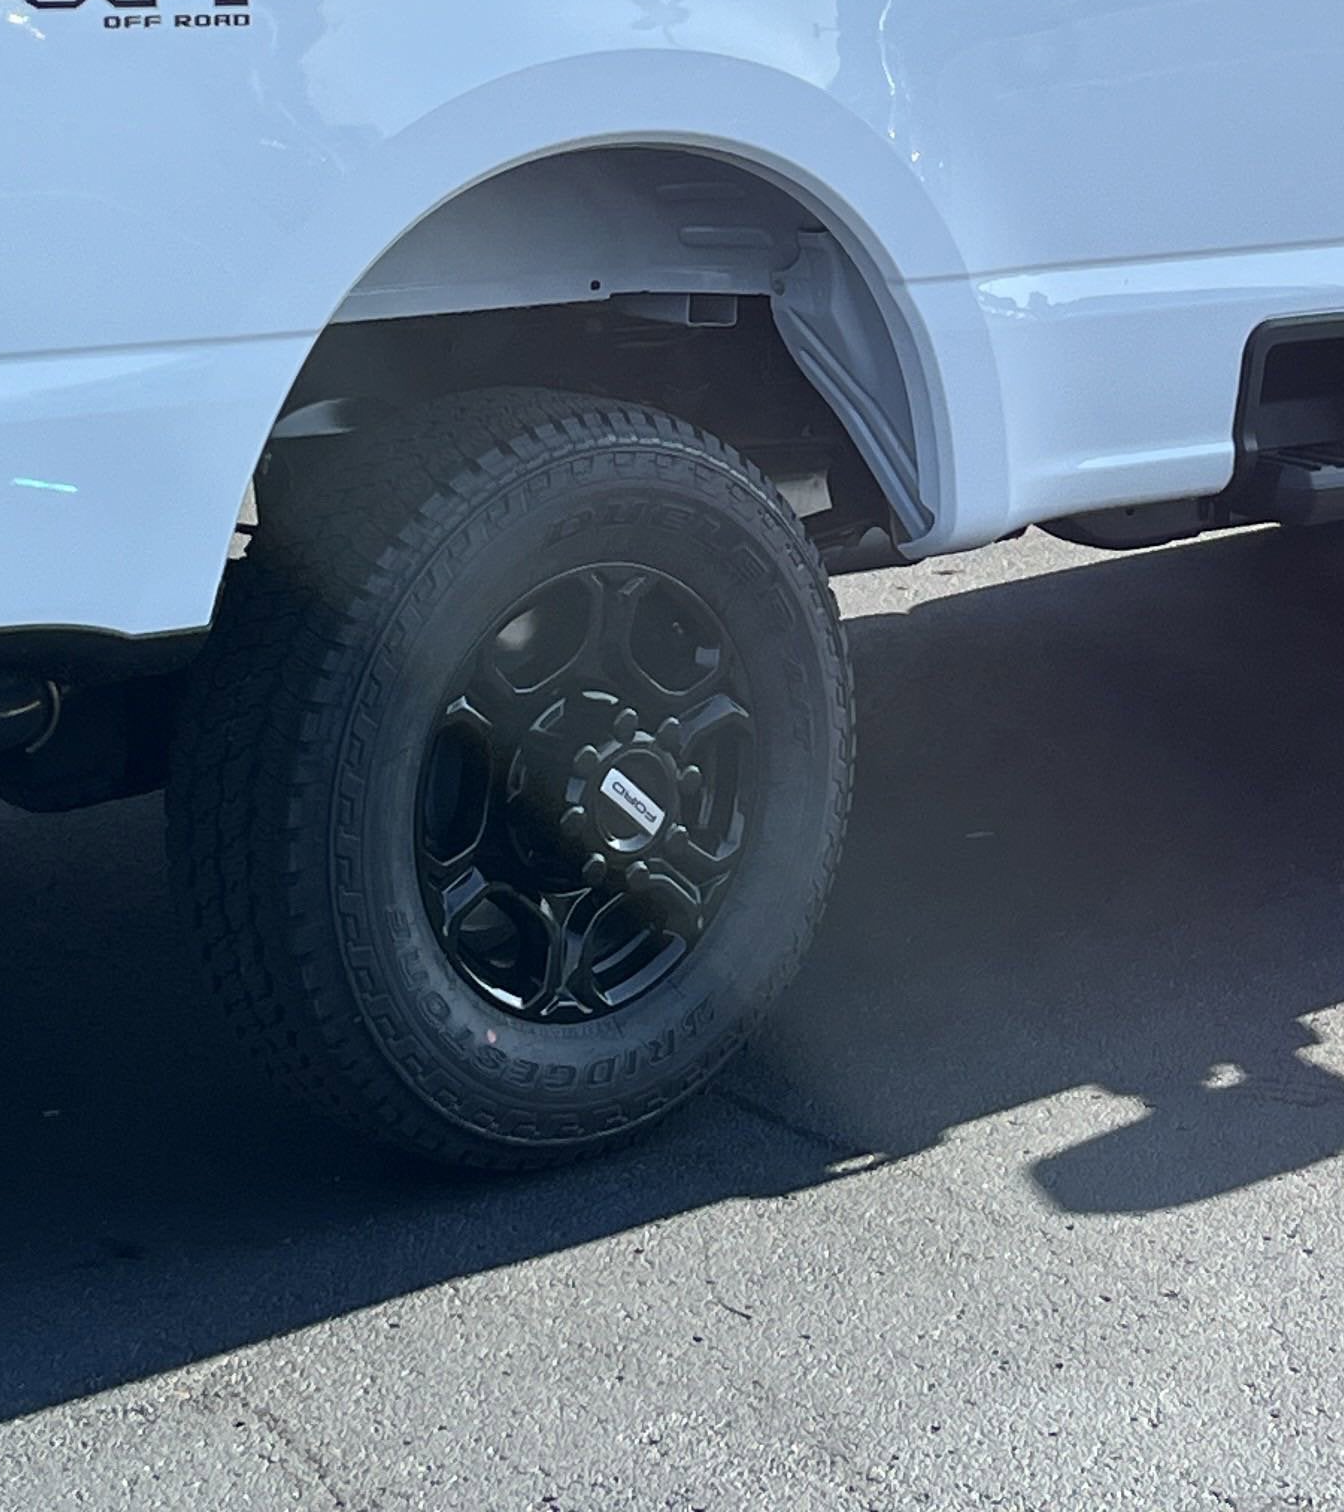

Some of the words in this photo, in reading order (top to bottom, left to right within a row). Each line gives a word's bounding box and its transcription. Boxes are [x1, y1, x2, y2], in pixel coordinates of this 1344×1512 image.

[103, 13, 161, 29] OFF
[174, 13, 251, 28] ROAD
[611, 780, 658, 823] FORD
[384, 905, 716, 1092] BRIDGESTONE
